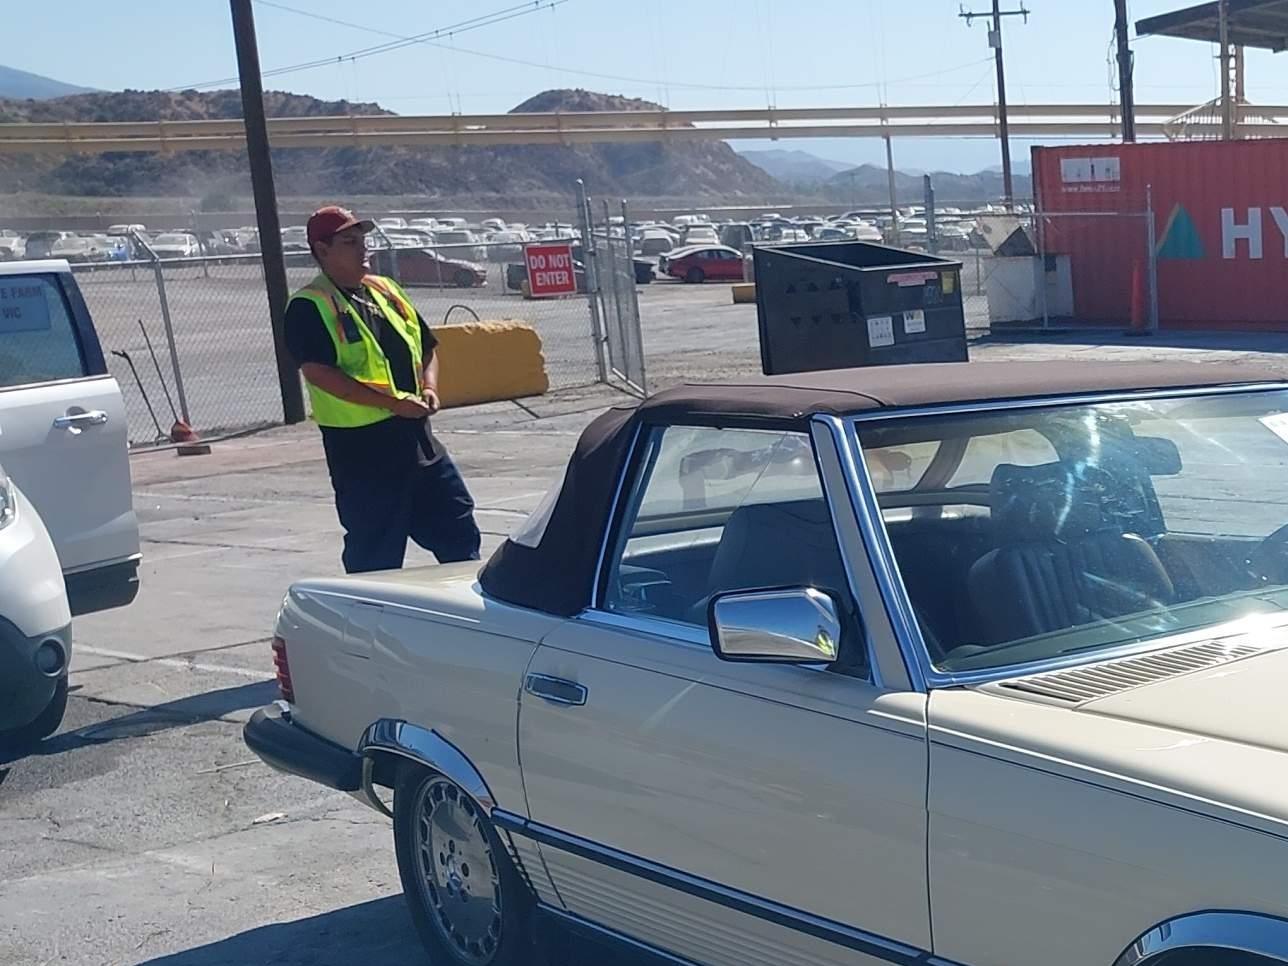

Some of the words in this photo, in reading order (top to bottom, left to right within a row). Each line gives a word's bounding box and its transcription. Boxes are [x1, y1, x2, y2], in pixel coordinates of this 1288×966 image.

[530, 255, 546, 270] DO
[549, 254, 569, 269] NOT
[536, 271, 569, 287] ENTER
